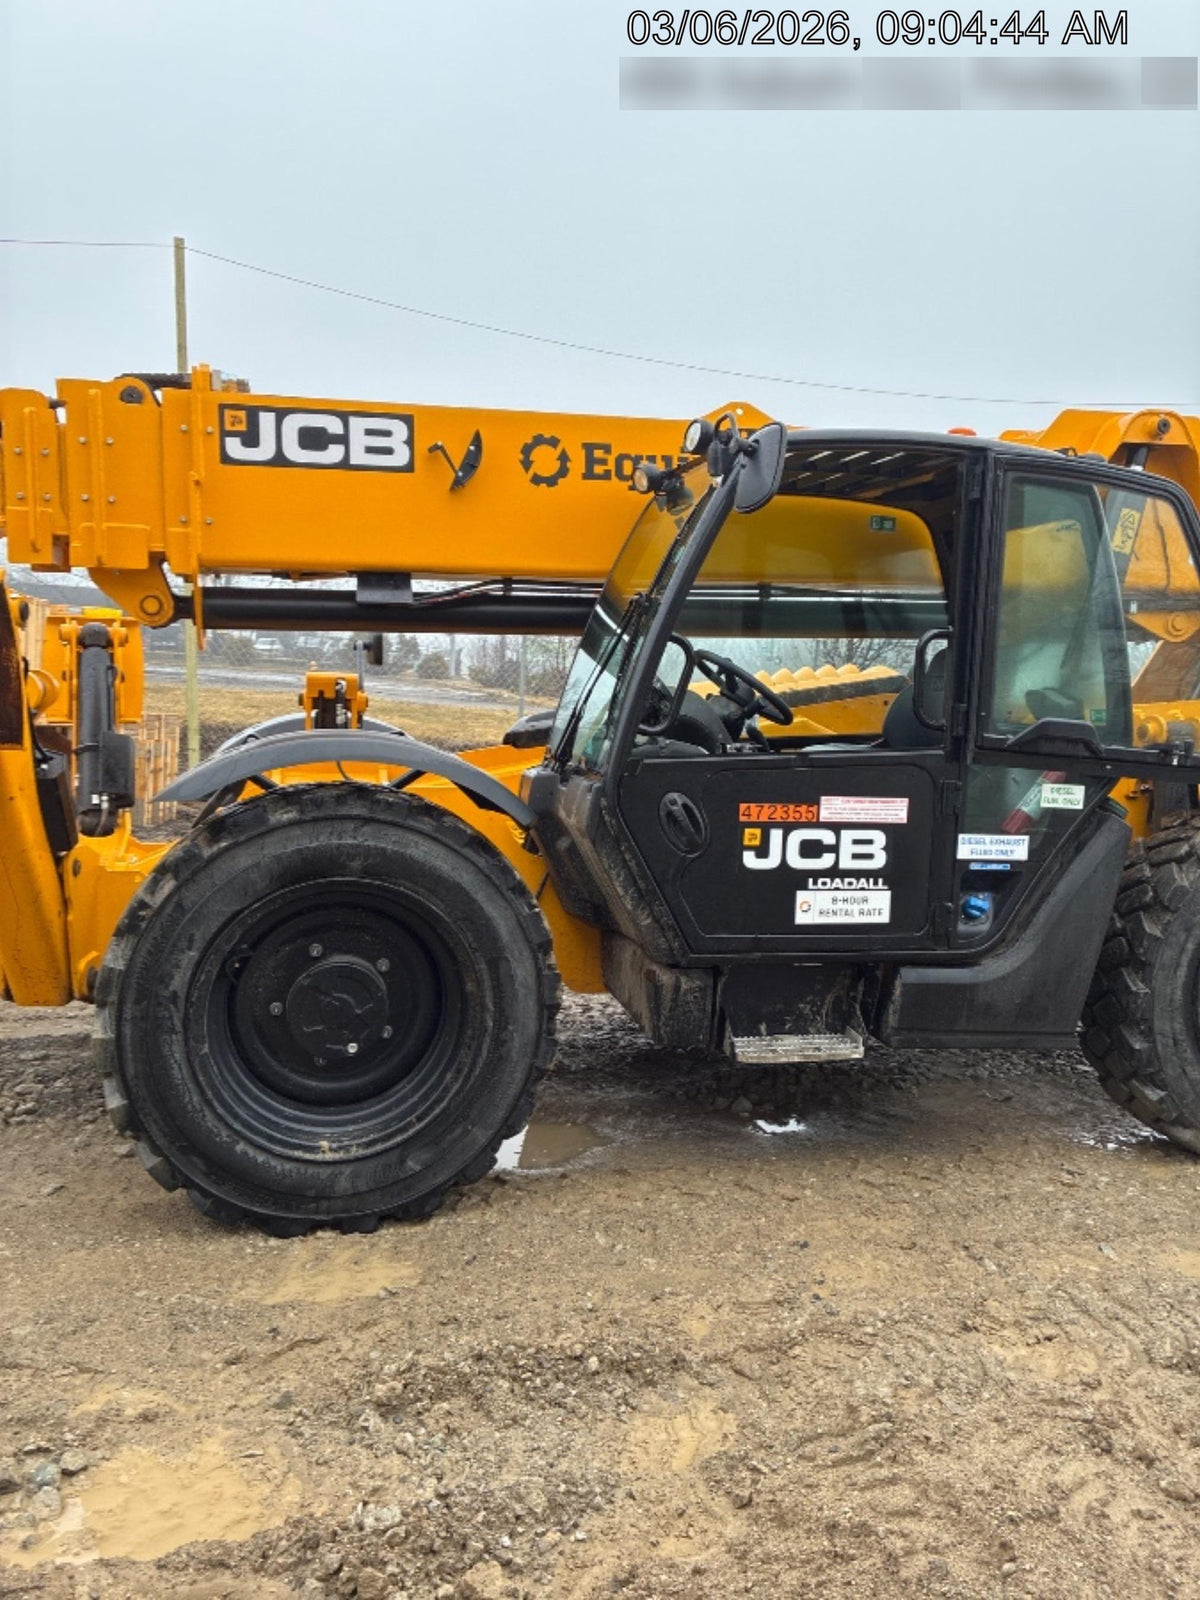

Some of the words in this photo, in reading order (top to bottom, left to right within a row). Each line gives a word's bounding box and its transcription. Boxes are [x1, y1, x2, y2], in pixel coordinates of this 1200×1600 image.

[224, 411, 411, 467] JCB
[741, 804, 817, 822] 472355
[960, 836, 987, 846] DIESEL
[989, 837, 1026, 847] EXHAUST
[742, 827, 887, 870] JCB
[970, 847, 993, 857] FLUID
[994, 848, 1016, 857] ONLY
[808, 877, 889, 890] LOADALL
[831, 895, 869, 906] 8-HOUR
[818, 907, 855, 918] RENTAL
[858, 907, 884, 917] RATE
